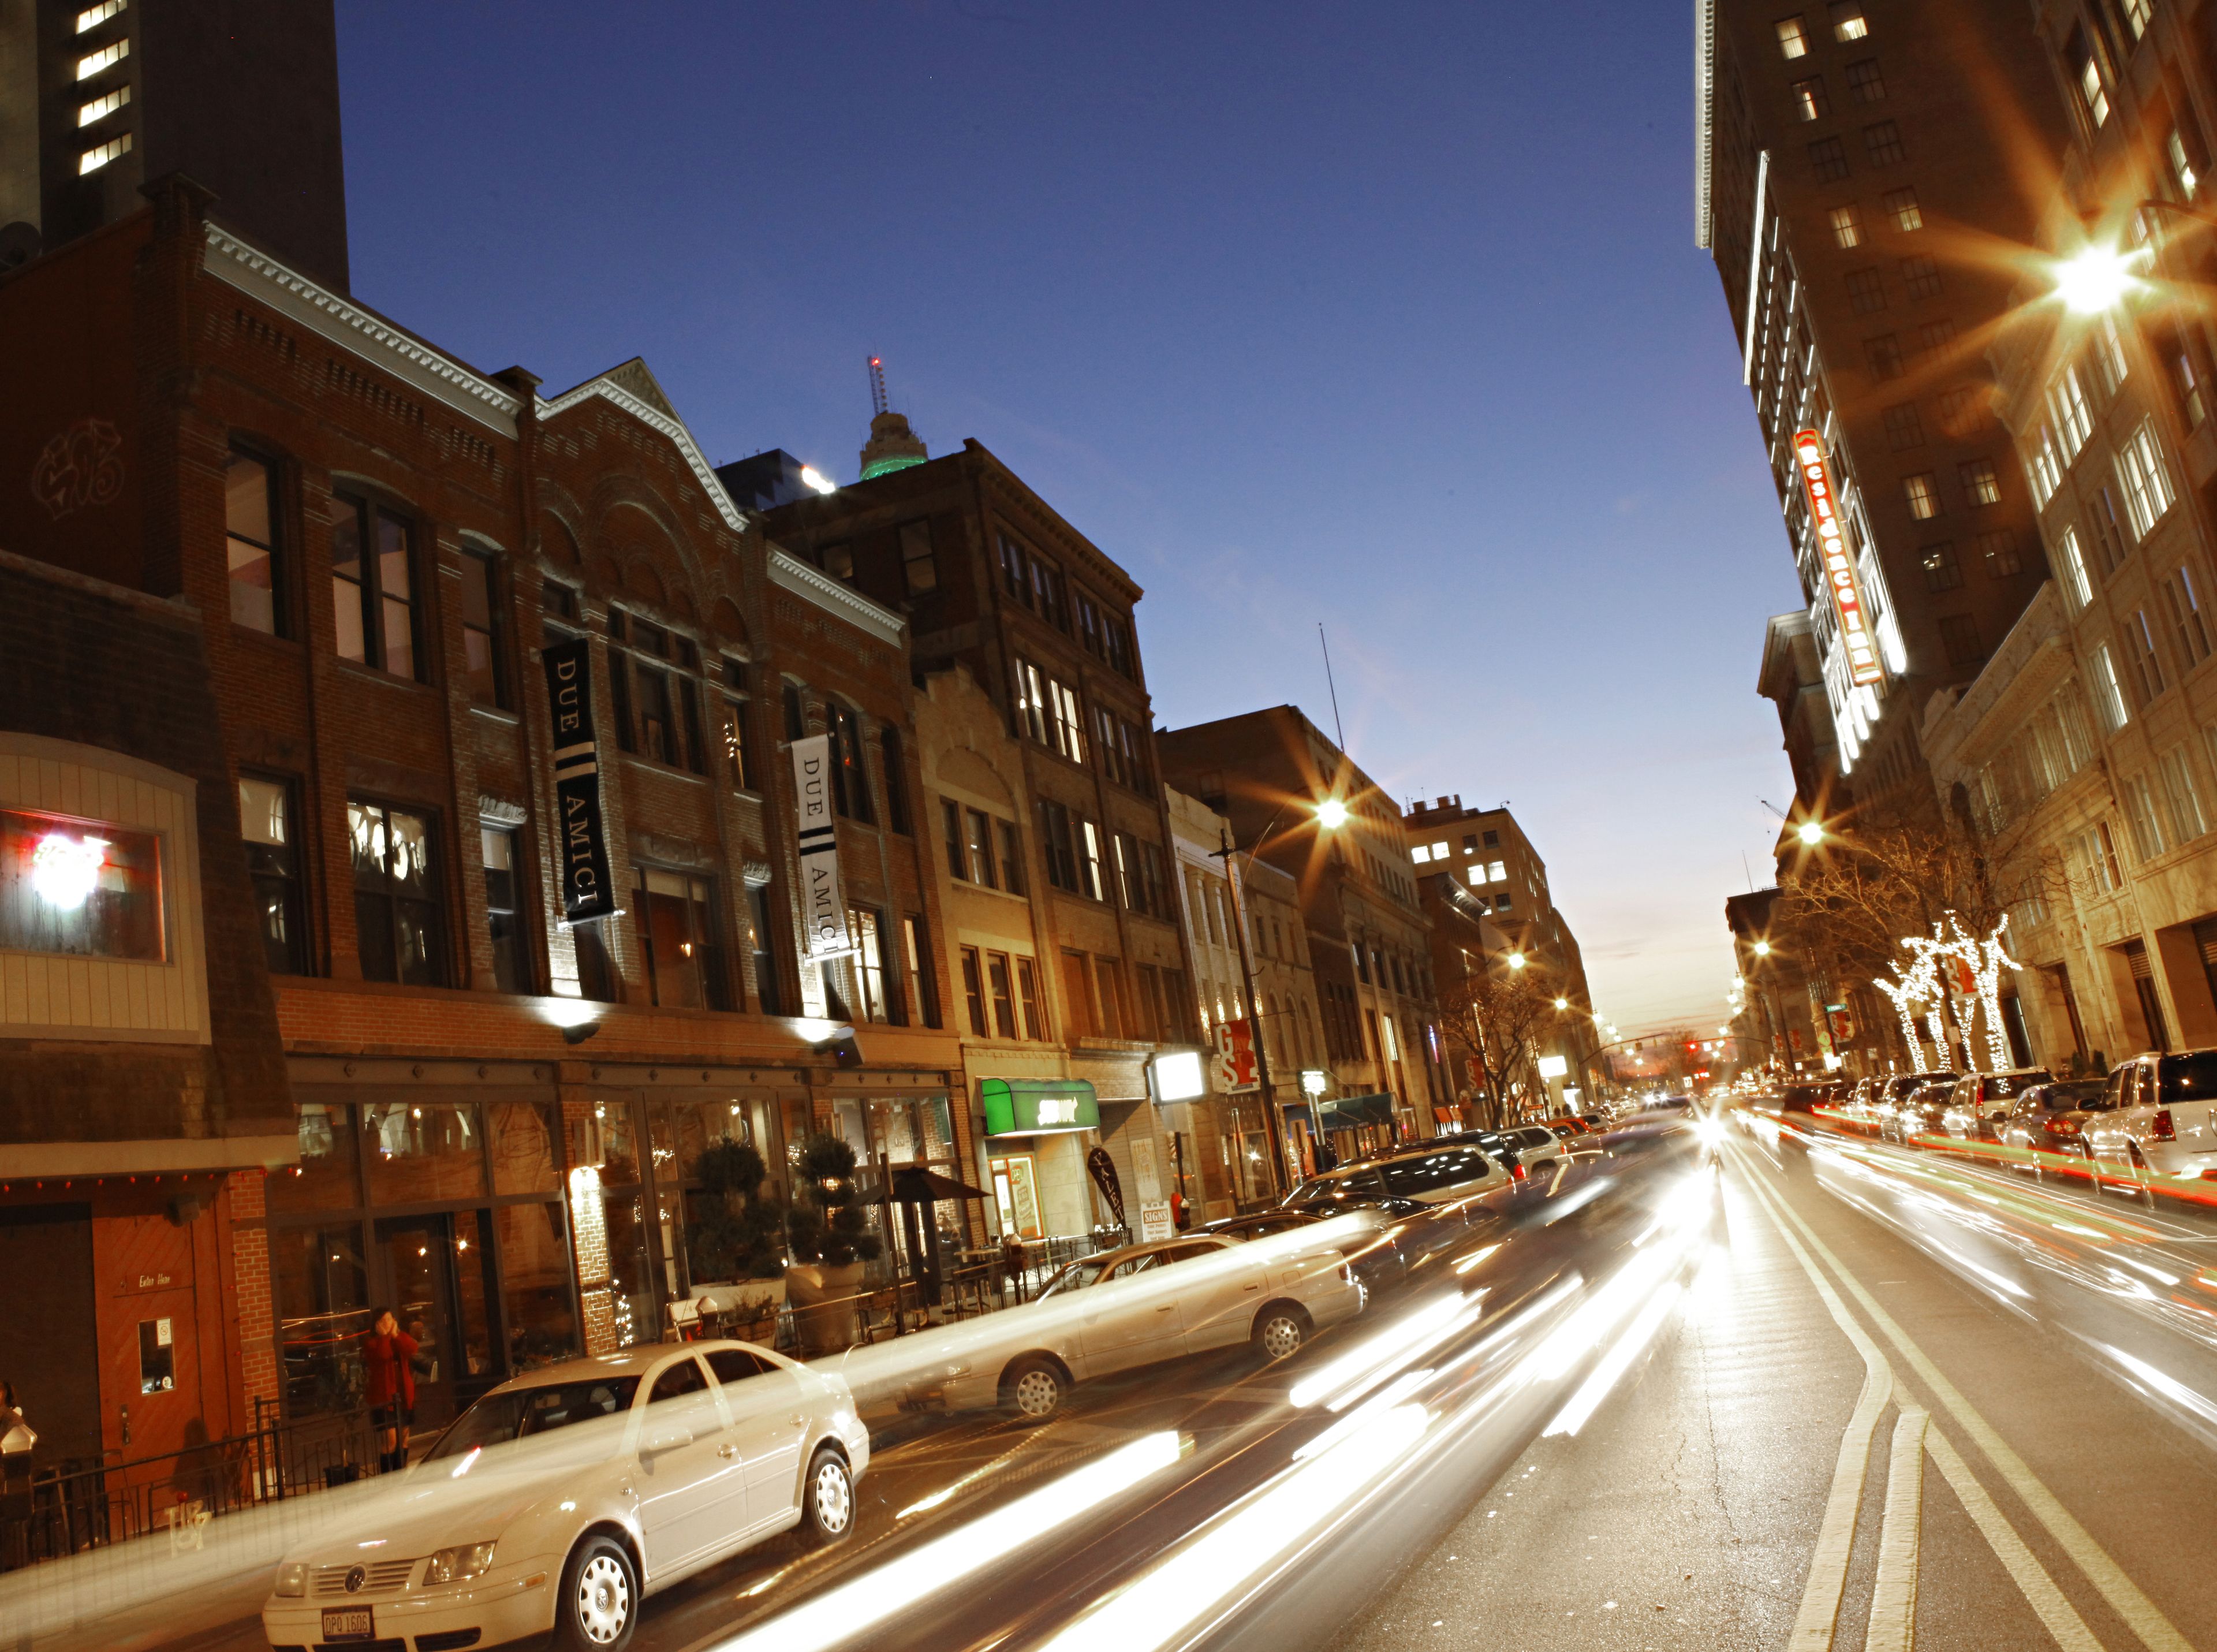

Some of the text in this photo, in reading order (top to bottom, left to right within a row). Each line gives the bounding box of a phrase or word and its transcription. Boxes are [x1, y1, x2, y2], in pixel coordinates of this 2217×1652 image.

[1798, 445, 1873, 665] Residence Inn
[558, 657, 598, 905] DUE AMICI
[804, 757, 839, 954] DUE AMICI
[1093, 1151, 1124, 1220] VALET
[1145, 1210, 1167, 1222] SIGNS
[140, 1273, 171, 1288] Enter Here
